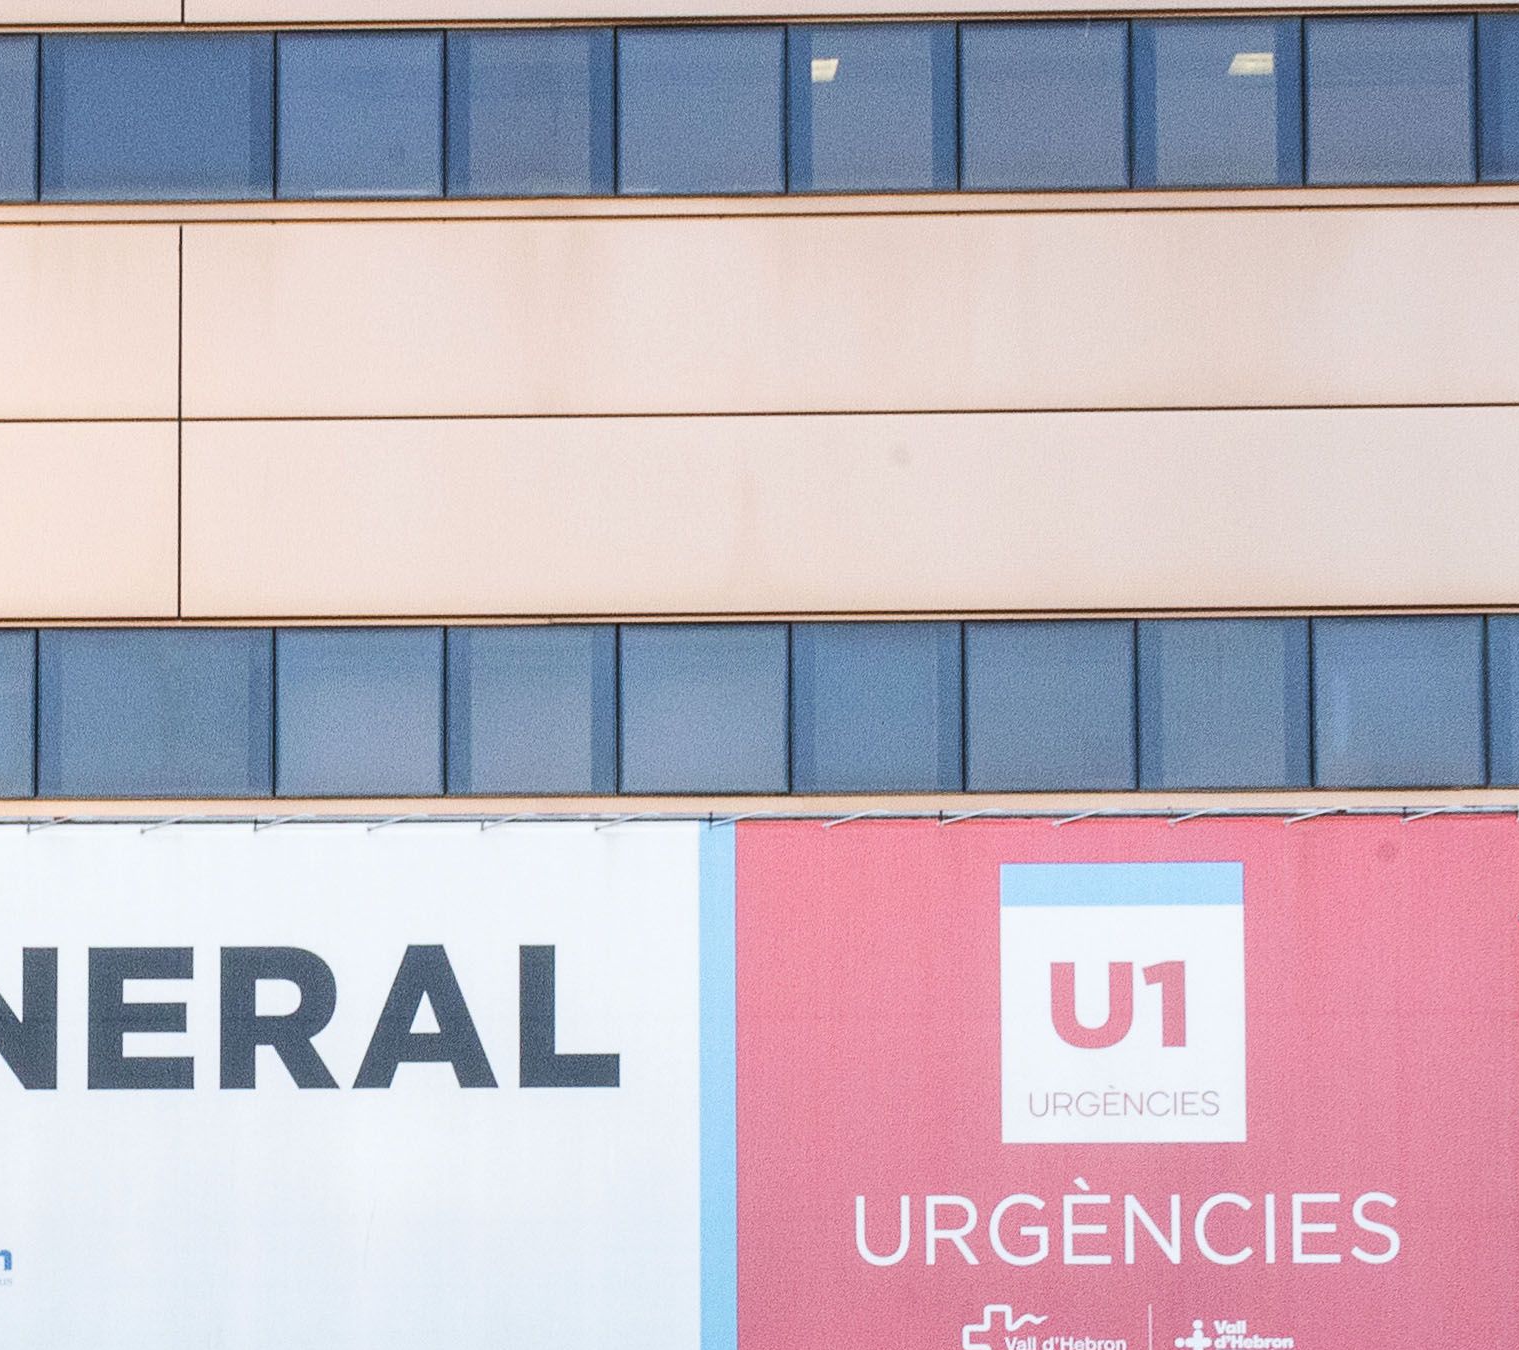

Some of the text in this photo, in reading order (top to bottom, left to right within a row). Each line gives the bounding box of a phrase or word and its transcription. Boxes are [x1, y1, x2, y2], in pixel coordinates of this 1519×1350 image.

[1049, 959, 1187, 1050] U1
[1027, 1085, 1220, 1118] URGÈNCIES
[854, 1176, 1402, 1267] URGÈNCIES
[1214, 1320, 1247, 1334] Vall
[1214, 1334, 1295, 1349] d'Hebron
